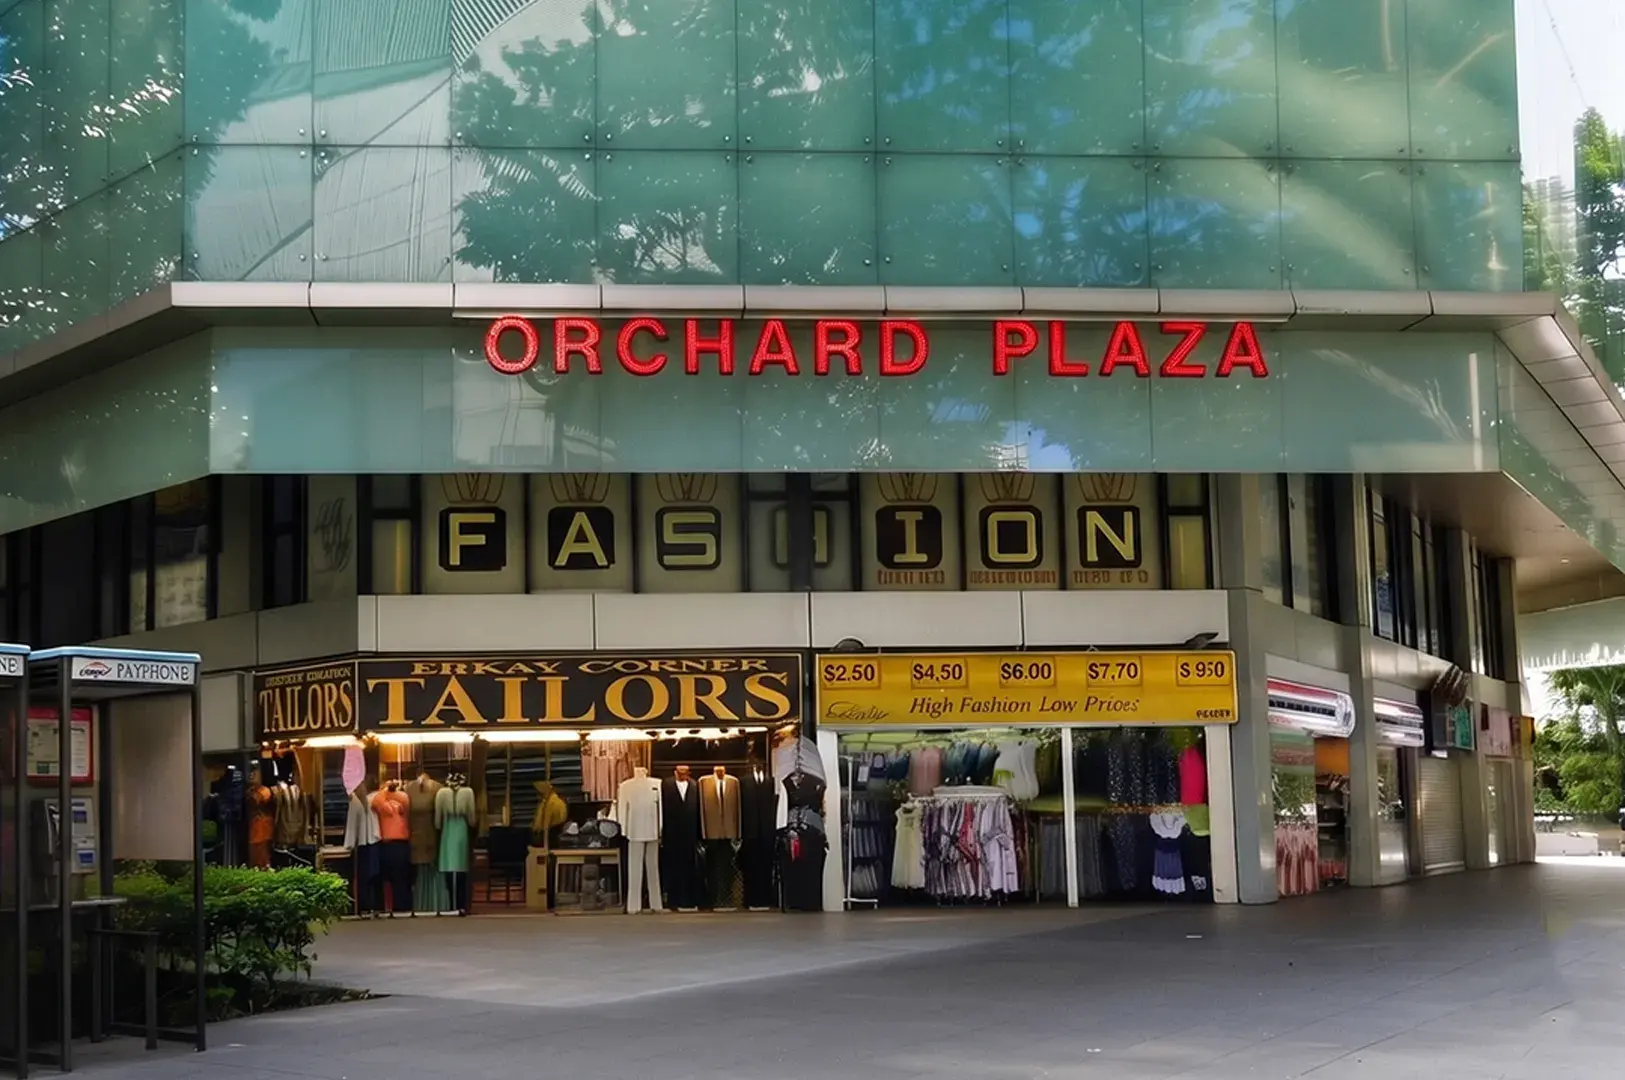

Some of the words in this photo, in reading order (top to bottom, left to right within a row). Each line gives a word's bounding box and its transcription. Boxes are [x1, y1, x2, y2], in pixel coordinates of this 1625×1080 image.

[484, 315, 931, 376] ORCHARD
[992, 319, 1269, 378] PLAZA
[116, 662, 190, 682] PAYPHONE
[410, 660, 564, 676] ERKAY
[578, 659, 769, 674] CORNER
[823, 663, 876, 683] $2.50
[1000, 662, 1053, 681] $6.00
[259, 680, 353, 734] TAILORS
[368, 672, 792, 727] TAILORS
[909, 697, 954, 719] High
[959, 697, 1032, 714] Fashion
[1039, 696, 1077, 713] Low
